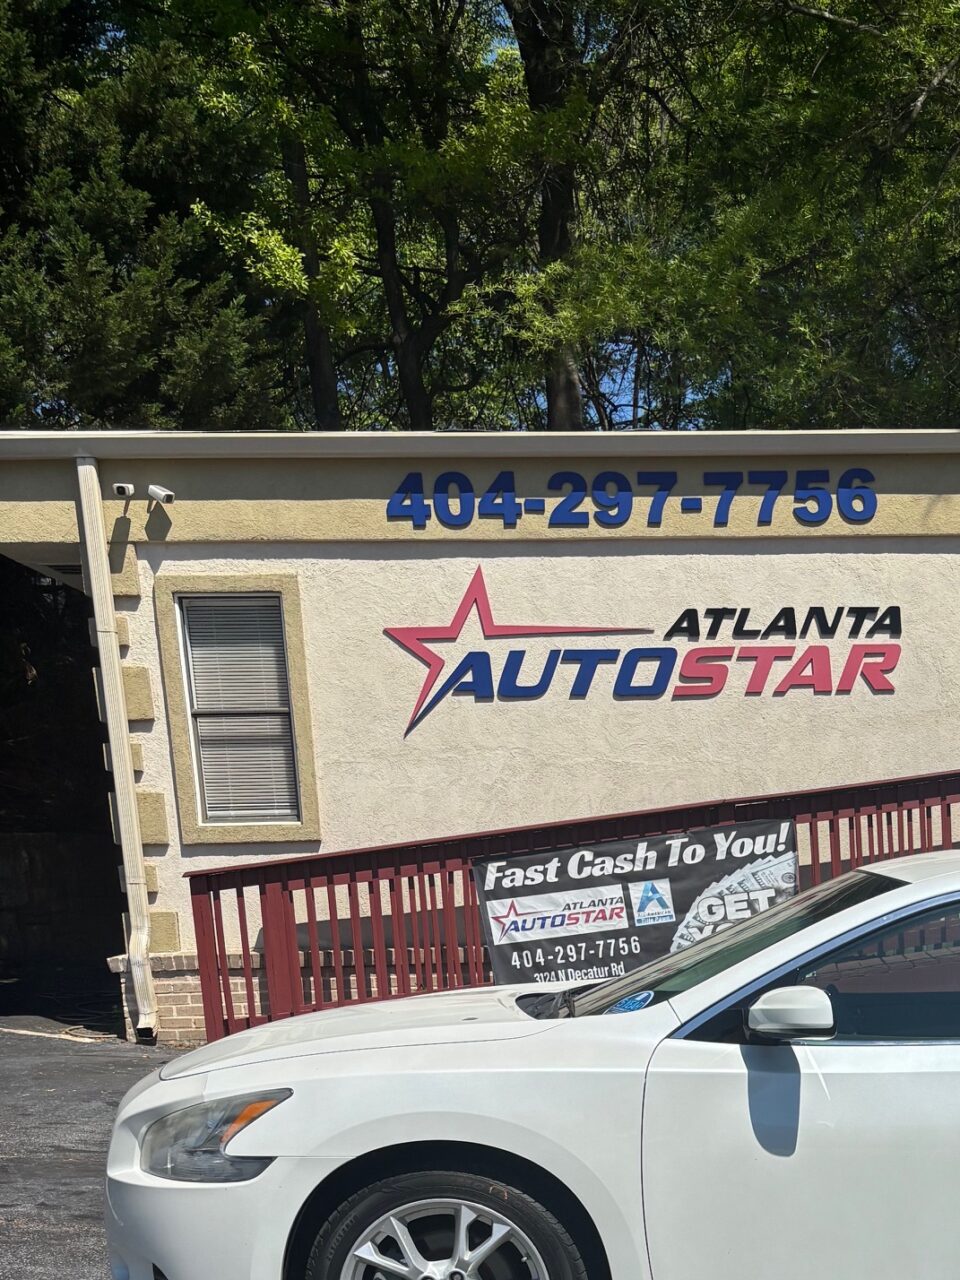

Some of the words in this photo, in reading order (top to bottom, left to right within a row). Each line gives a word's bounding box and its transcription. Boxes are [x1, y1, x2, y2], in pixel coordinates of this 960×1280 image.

[386, 468, 878, 528] 404-297-7756
[664, 605, 902, 641] ATLANTA
[428, 643, 902, 702] AUTOSTAR
[484, 859, 561, 891] Fast
[567, 843, 657, 879] Cash
[665, 836, 706, 866] To
[713, 822, 791, 861] You!
[505, 905, 625, 934] AUTOSTAR
[562, 896, 624, 912] ATLANTA
[697, 888, 776, 923] GET
[511, 936, 641, 970] 404-297-7756
[534, 971, 557, 983] 3124
[557, 968, 568, 982] N
[568, 964, 609, 982] Decatur
[611, 960, 625, 976] Rd
